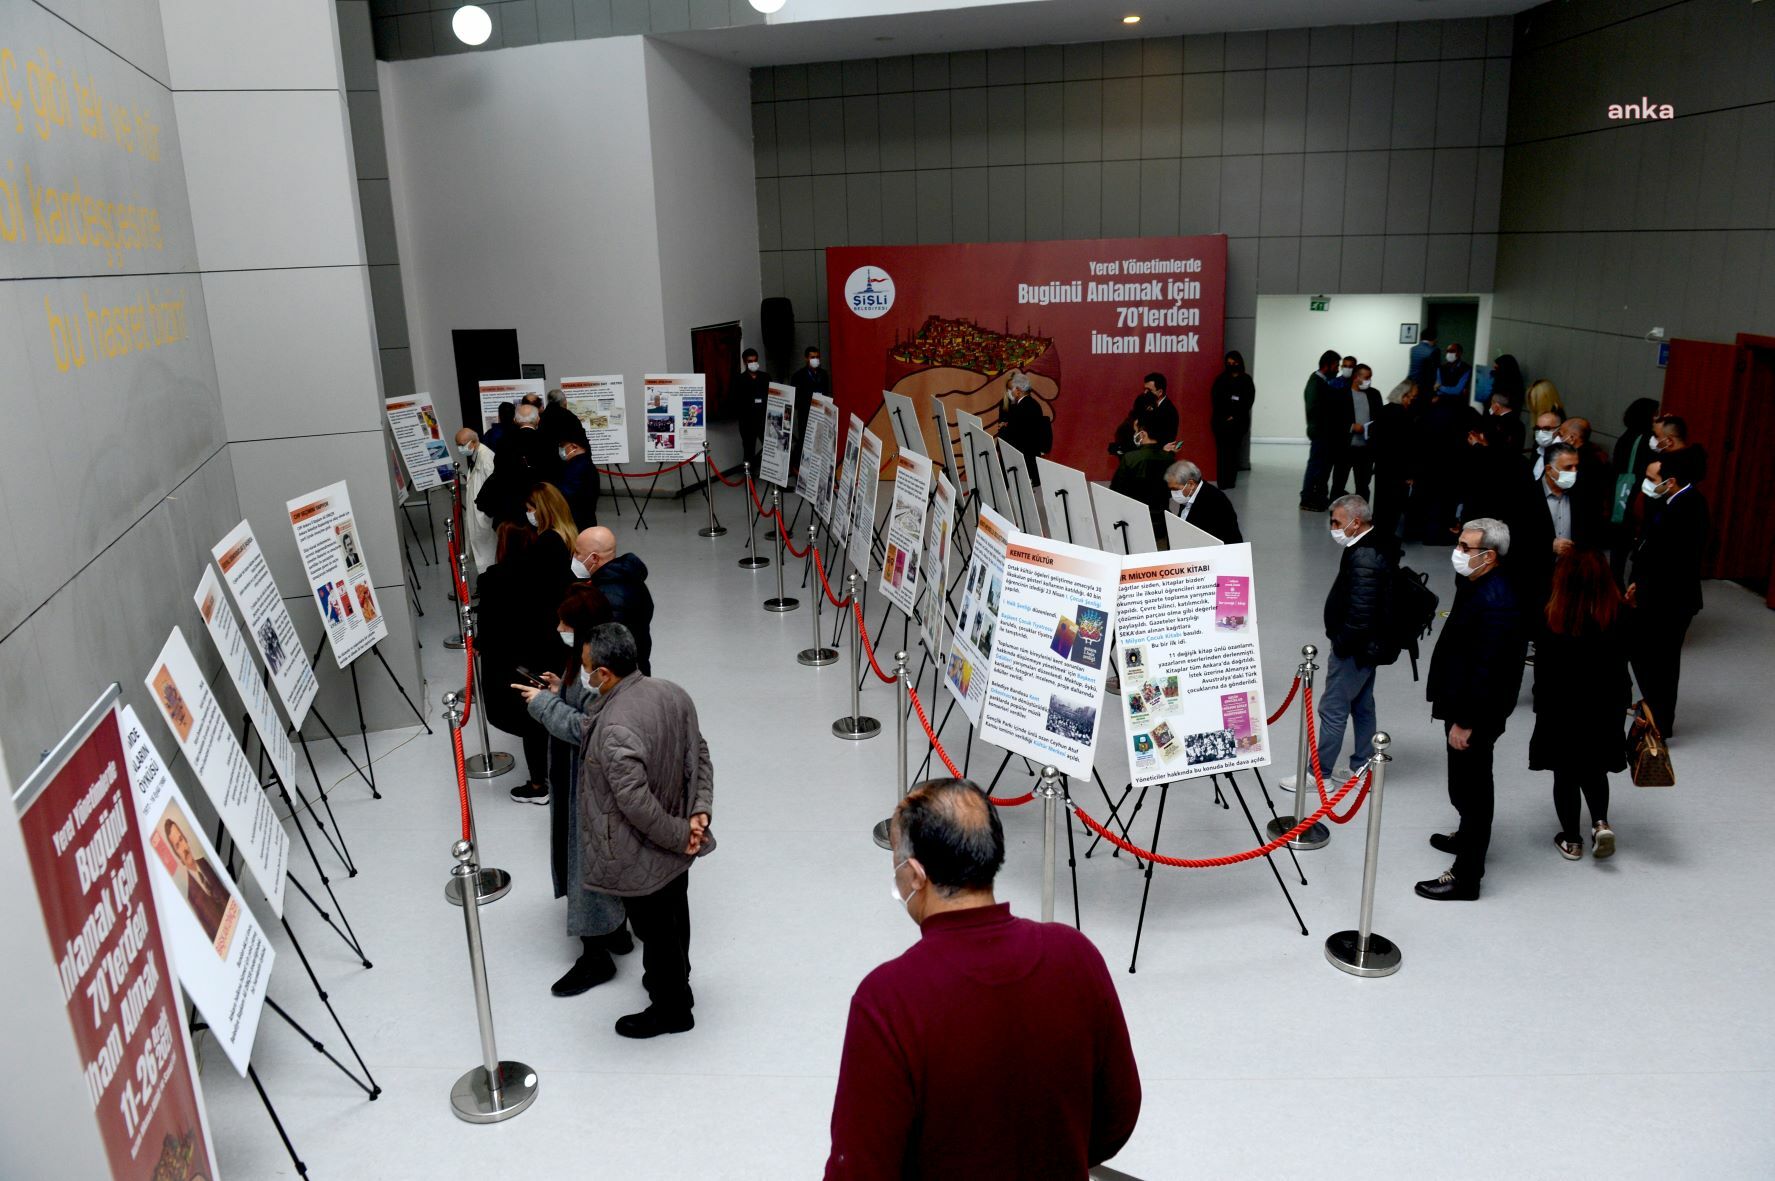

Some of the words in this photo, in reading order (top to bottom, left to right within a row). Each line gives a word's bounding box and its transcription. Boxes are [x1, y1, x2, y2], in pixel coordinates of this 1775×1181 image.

[26, 47, 73, 143] gibi
[72, 64, 112, 143] tek
[1089, 260, 1119, 277] Yerel
[1122, 258, 1202, 275] Yönetimlerde
[1018, 281, 1082, 306] Bugünü
[1086, 280, 1162, 303] Anlamak
[1167, 278, 1201, 306] için
[1116, 306, 1200, 328] 70'lerden
[44, 293, 87, 373] bu
[82, 291, 151, 361] hasret
[1091, 329, 1140, 355] İlham
[1143, 331, 1200, 354] Almak
[1009, 549, 1030, 559] KENTTE
[1031, 553, 1054, 565] KÜLTÜR
[1128, 569, 1157, 580] MİLYON
[1159, 567, 1184, 578] ÇOCUK
[1186, 563, 1209, 573] KİTABI
[1162, 578, 1183, 586] kitaplar
[1164, 584, 1195, 594] öğrencileri
[1116, 599, 1142, 607] okunmuş
[1164, 593, 1188, 601] toplama
[1189, 590, 1215, 598] yarışması
[1118, 614, 1144, 622] çözümün
[1145, 611, 1165, 619] parçası
[1194, 605, 1218, 613] değerler
[1139, 604, 1156, 612] Çevre
[1149, 617, 1175, 625] Gazeteler
[1146, 634, 1163, 642] Çocuk
[1176, 649, 1196, 658] değişik
[1198, 647, 1212, 655] kitap
[1187, 654, 1221, 663] eserlerinden
[1165, 665, 1188, 674] Kitaplar
[1202, 660, 1229, 668] Ankara'da
[1203, 668, 1223, 676] üzerine
[1224, 665, 1248, 674] Almanya
[1135, 772, 1165, 783] Yöneticiler
[1167, 768, 1192, 778] hakkında
[1202, 763, 1223, 772] konuda
[1235, 758, 1249, 766] dava
[52, 812, 76, 857] Yerel
[72, 760, 118, 831] Yönetimlerde
[75, 789, 128, 897] Bugünü
[58, 887, 116, 1005] nlamak
[111, 850, 139, 918] için
[86, 901, 149, 1030] 70'lerden
[83, 1022, 124, 1112] lham
[120, 950, 160, 1045] Almak
[120, 1038, 158, 1140] 11-26
